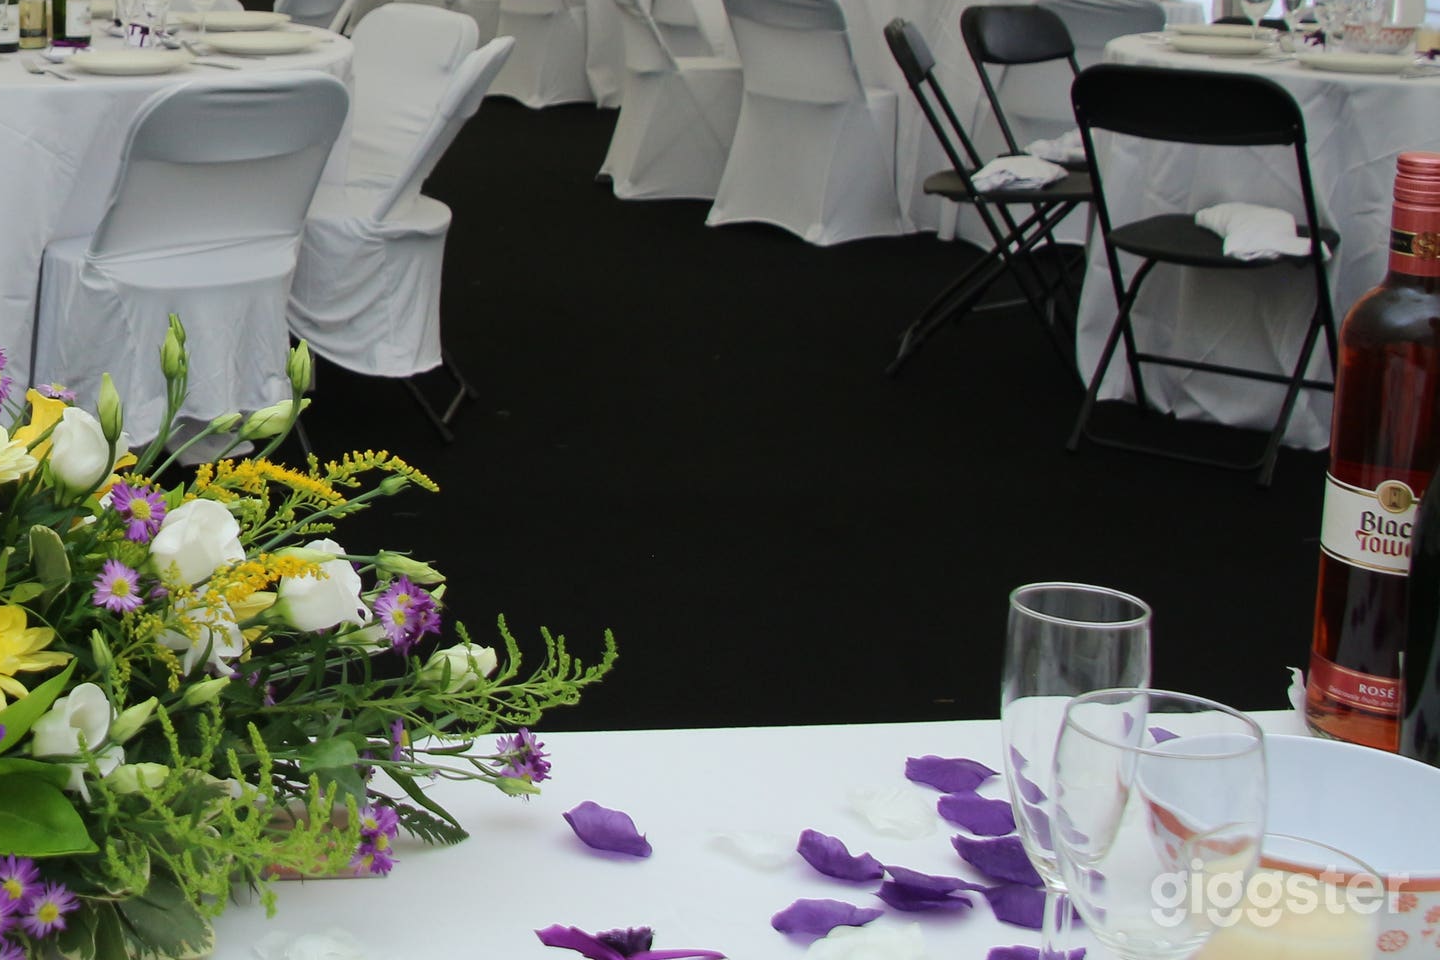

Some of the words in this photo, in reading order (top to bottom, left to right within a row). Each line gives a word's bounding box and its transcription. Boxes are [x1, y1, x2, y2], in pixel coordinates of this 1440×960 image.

[1360, 511, 1412, 538] Blac
[1355, 530, 1411, 557] Tow
[1359, 683, 1395, 699] ROSÉ
